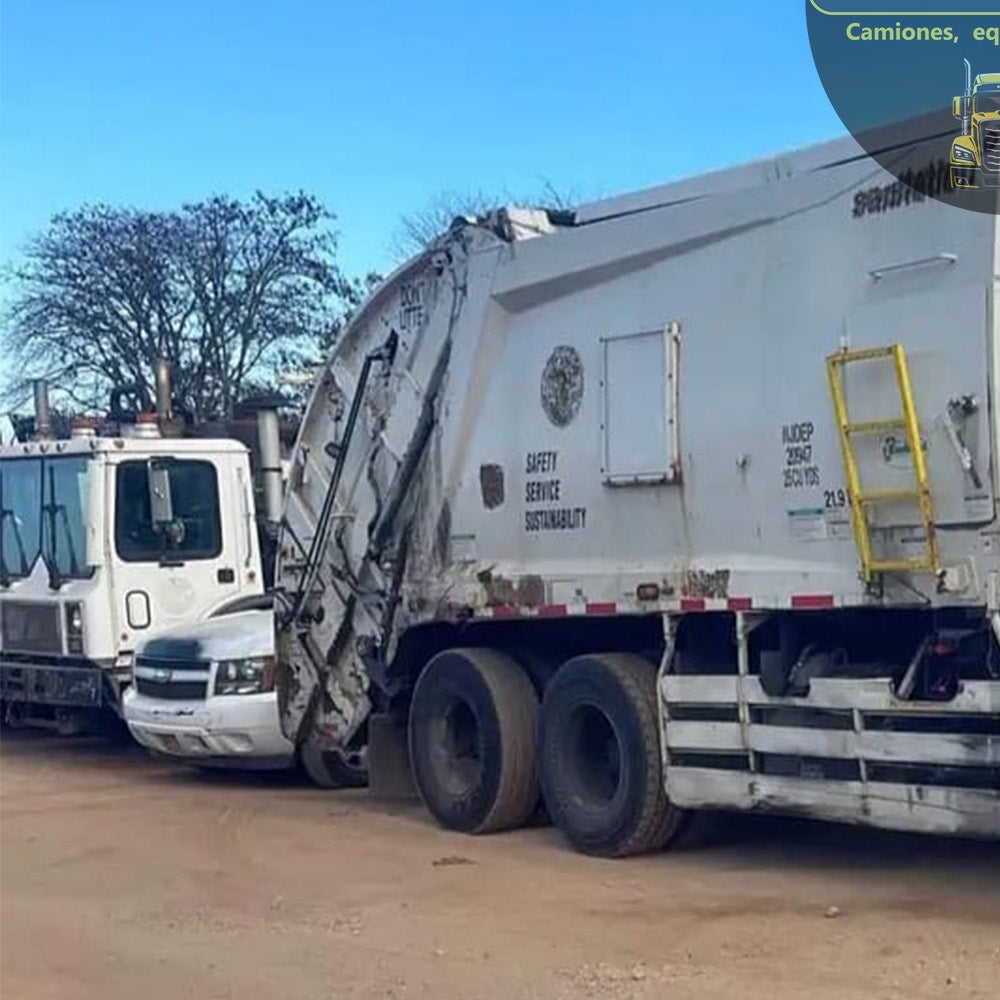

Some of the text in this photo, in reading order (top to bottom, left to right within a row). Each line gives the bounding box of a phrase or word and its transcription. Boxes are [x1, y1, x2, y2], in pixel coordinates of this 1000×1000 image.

[526, 451, 558, 474] SAFETY
[525, 480, 560, 502] SERVICE
[824, 490, 846, 508] 21.9
[525, 508, 587, 532] SUSTAINABILITY
